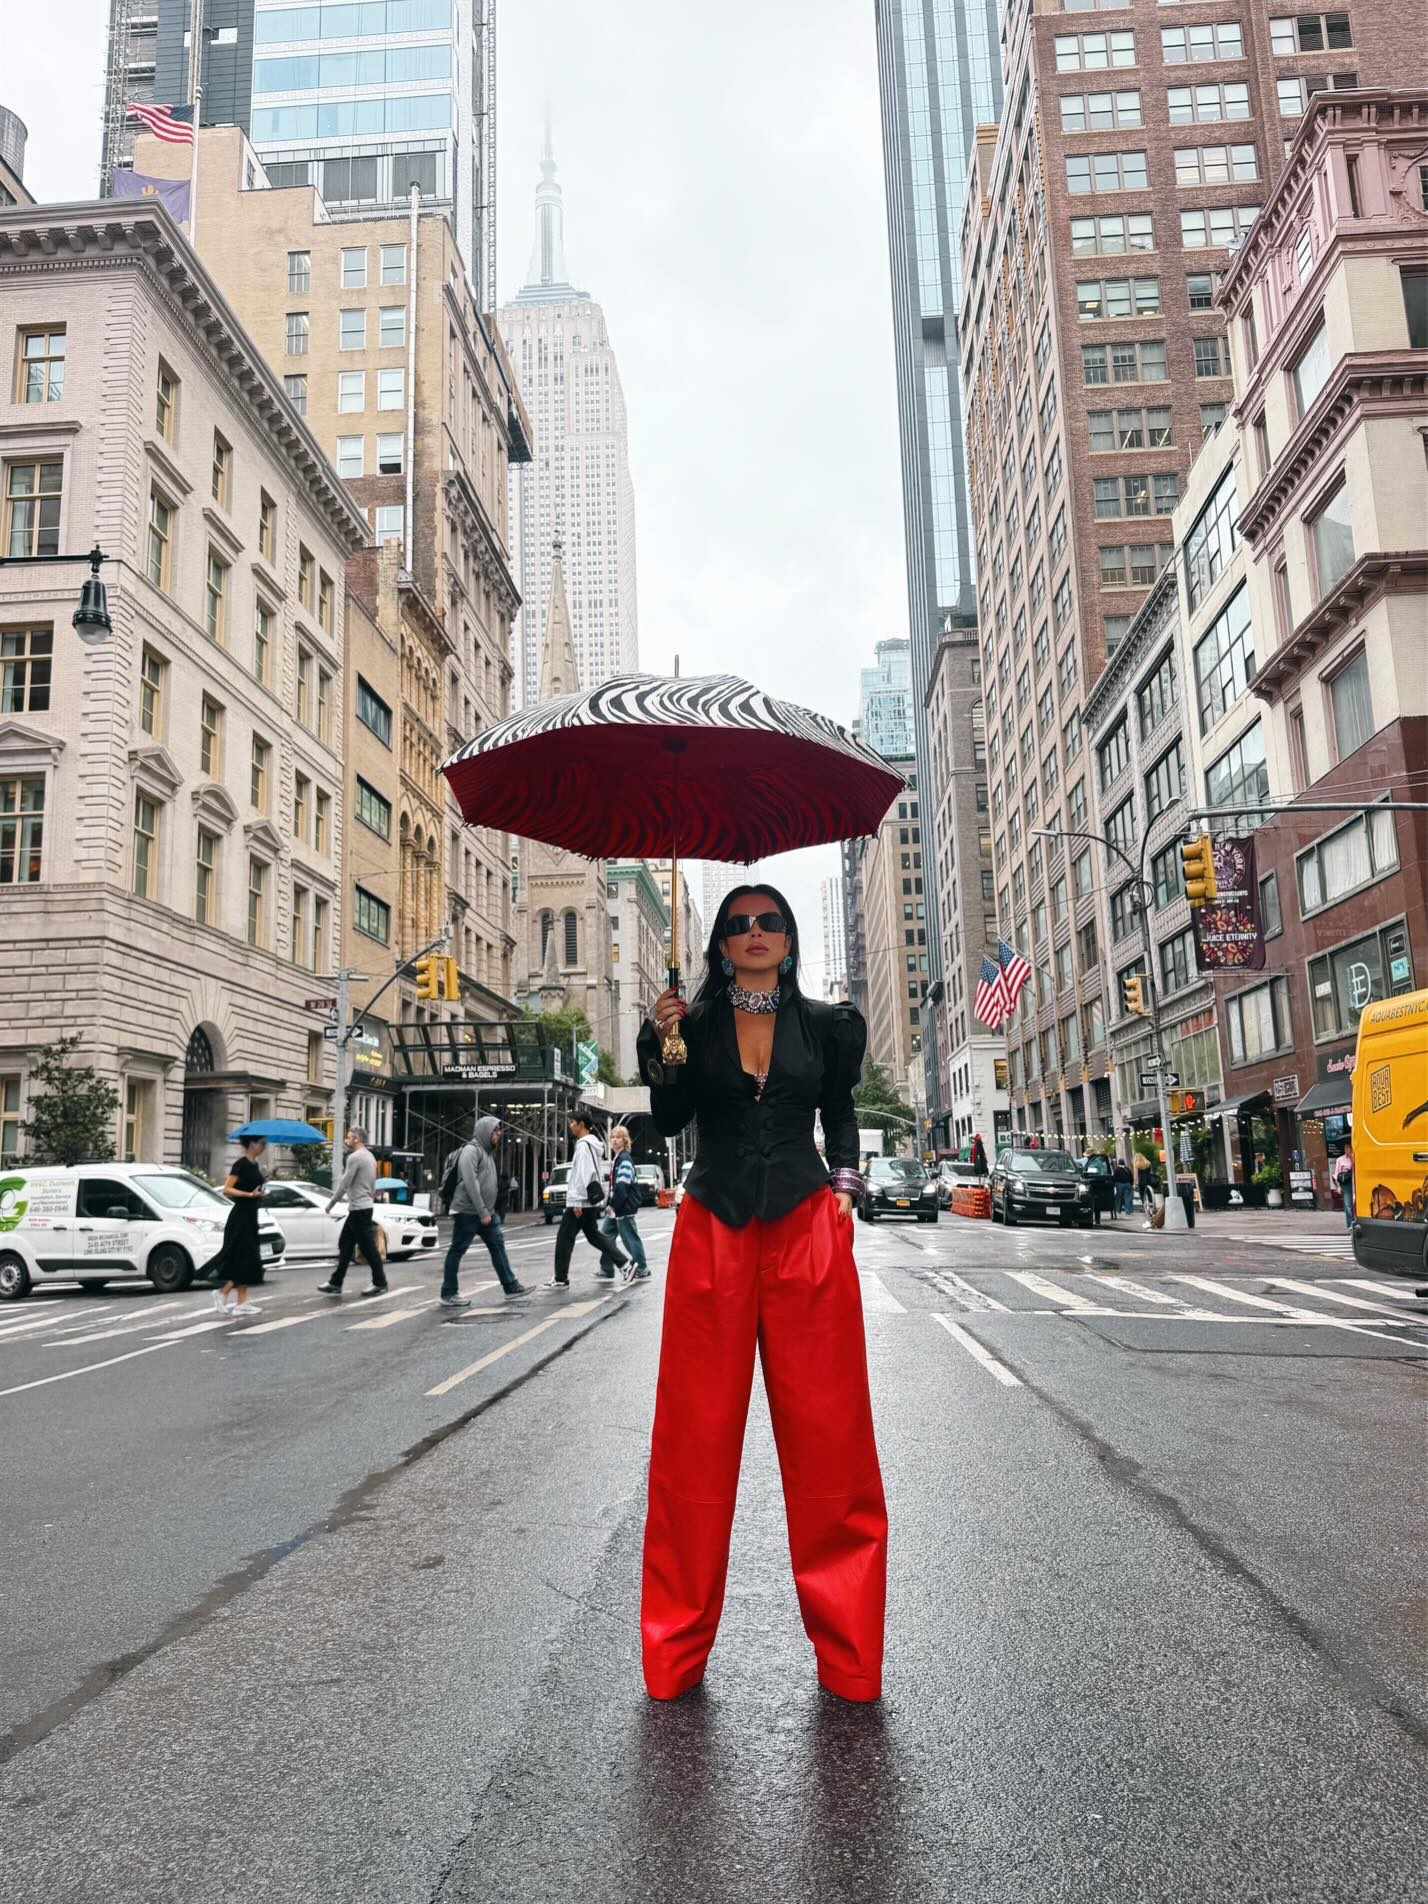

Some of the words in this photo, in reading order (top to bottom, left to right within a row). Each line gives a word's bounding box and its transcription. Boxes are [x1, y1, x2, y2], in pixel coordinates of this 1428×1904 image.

[1232, 847, 1245, 870] YORK
[1202, 933, 1224, 942] JUICE
[1226, 932, 1257, 941] ETERNITY
[468, 1071, 498, 1079] BAGELS
[477, 1064, 516, 1072] ESPRESSO
[1372, 1069, 1389, 1090] AQUA
[1373, 1088, 1389, 1109] BEST
